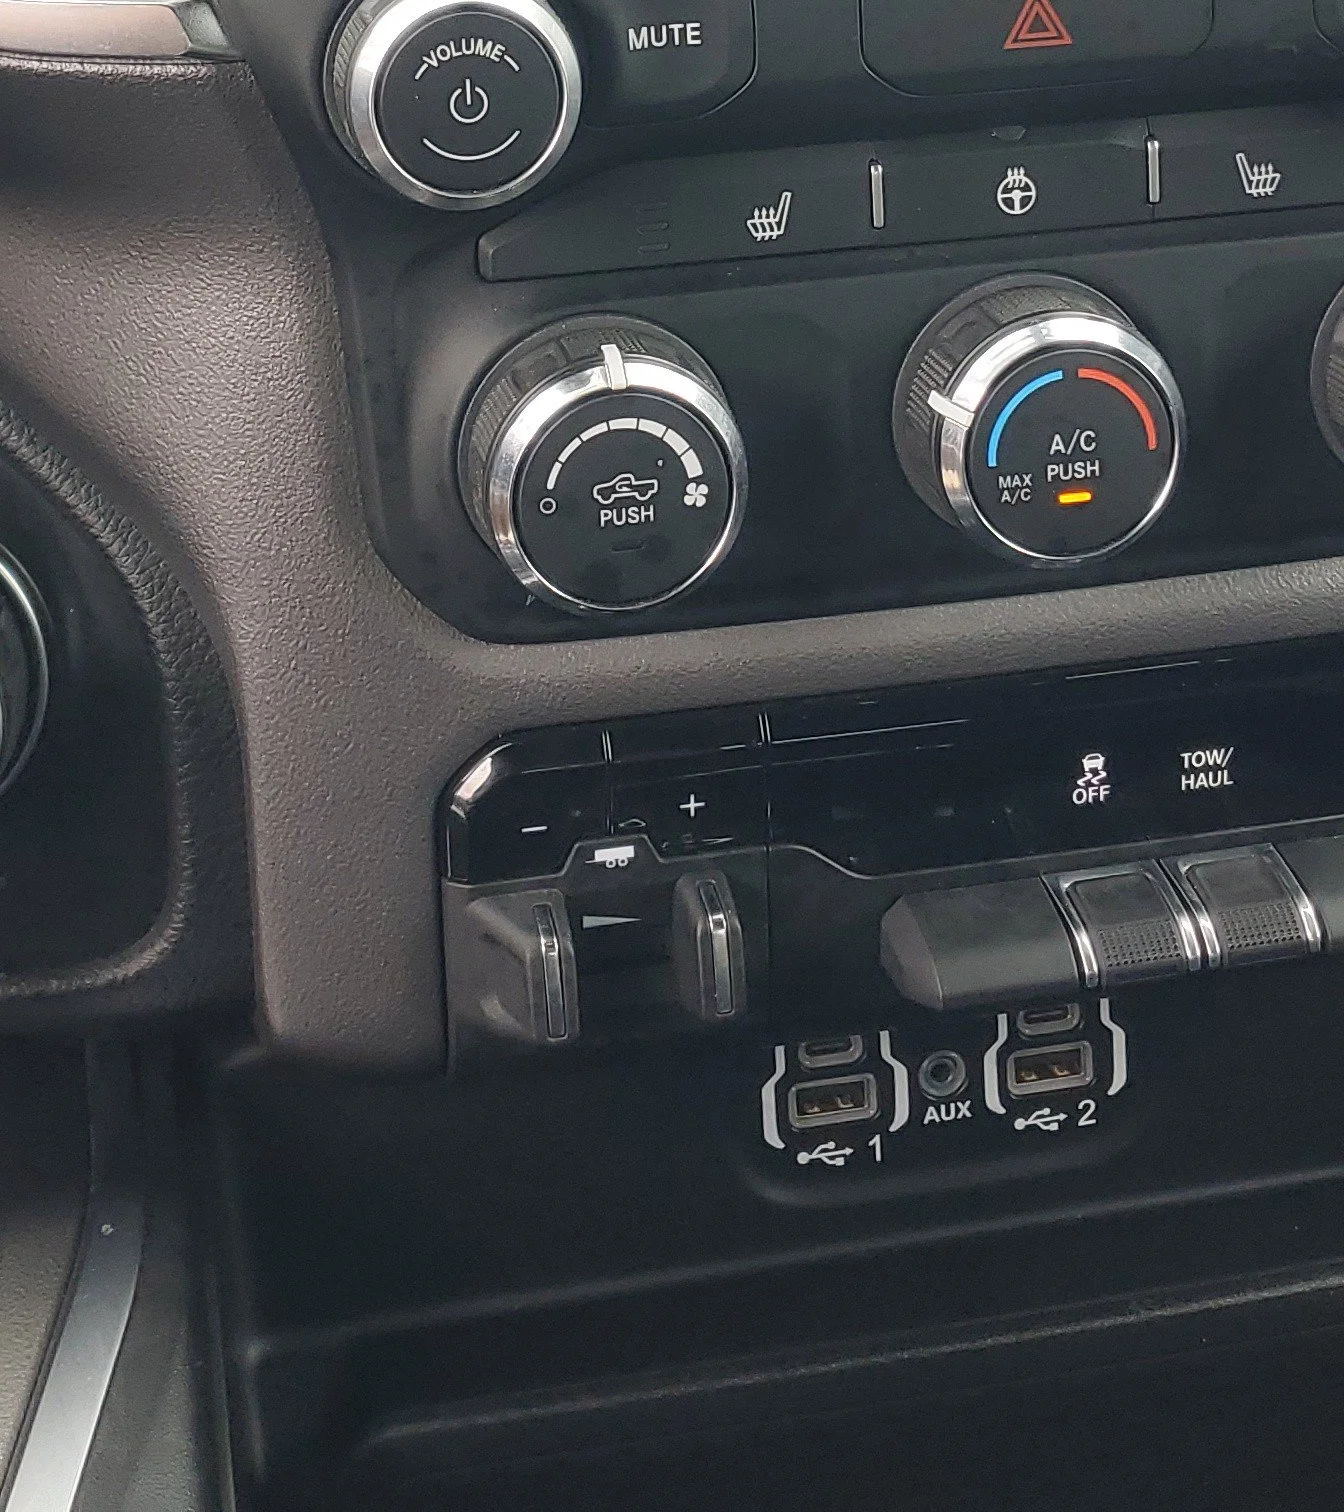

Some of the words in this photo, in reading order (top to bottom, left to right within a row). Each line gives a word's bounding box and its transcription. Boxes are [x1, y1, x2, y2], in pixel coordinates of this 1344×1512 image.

[627, 22, 702, 53] MUTE
[421, 37, 507, 69] VOLUME
[1048, 428, 1098, 457] A/C
[998, 474, 1034, 490] MAX
[1046, 458, 1101, 483] PUSH
[1000, 488, 1032, 504] A/C
[598, 504, 656, 528] PUSH
[1180, 746, 1235, 770] TOW/
[1180, 765, 1236, 791] HAUL
[1072, 783, 1112, 806] OFF
[923, 1100, 974, 1127] AUX
[1076, 1099, 1097, 1127] 2
[869, 1135, 884, 1163] 1
